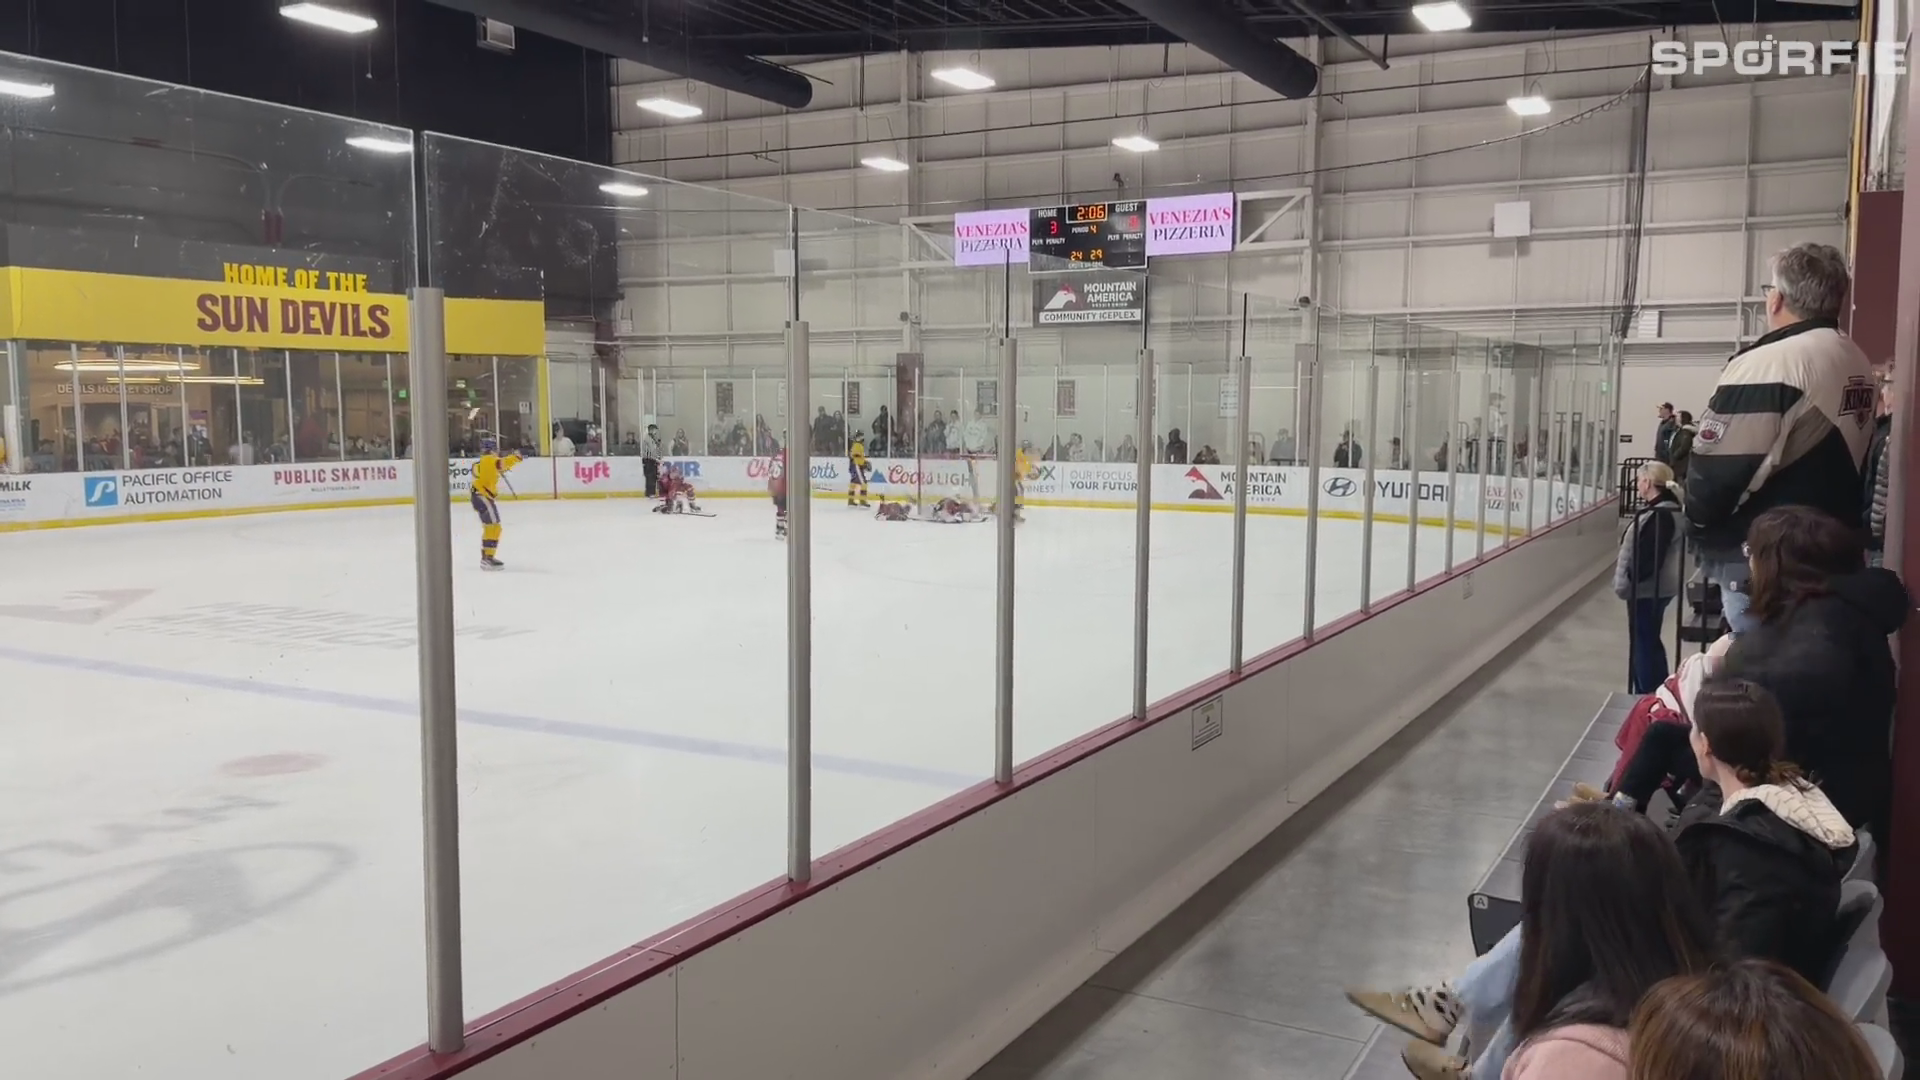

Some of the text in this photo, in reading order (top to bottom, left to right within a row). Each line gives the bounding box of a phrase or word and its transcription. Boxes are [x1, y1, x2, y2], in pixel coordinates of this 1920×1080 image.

[1038, 209, 1058, 218] HOME
[1077, 206, 1105, 220] 2:06
[1115, 203, 1138, 212] GUEST
[1149, 207, 1231, 225] VENEZIA'S
[956, 221, 1027, 238] VENEZIA'S
[1050, 221, 1057, 234] 3
[1090, 225, 1097, 234] 4
[1154, 225, 1225, 241] PIZZERIA
[961, 238, 1024, 253] PIZZERIA
[1070, 251, 1083, 261] 24
[1090, 249, 1102, 260] 29
[223, 262, 368, 293] HOME OF THE
[1084, 281, 1137, 293] MOUNTAIN
[1087, 292, 1133, 303] AMERICA
[197, 293, 390, 339] SUN DEVILS
[1044, 311, 1136, 321] COMMUNITY ICEPLEX
[57, 384, 173, 394] DELS HOCEY SHOP
[122, 470, 233, 487] PACIFIC OFFICE
[274, 466, 397, 485] PUBLIC SKATING
[574, 461, 610, 484] lyft
[1070, 470, 1092, 480] OUR
[1220, 471, 1287, 484] MNTAIN
[937, 473, 971, 487] LIGH
[1070, 481, 1138, 491] YOUR FUTUR
[124, 488, 222, 505] AUTOMATION
[1224, 484, 1282, 496] AERICA
[1476, 897, 1486, 907] A
